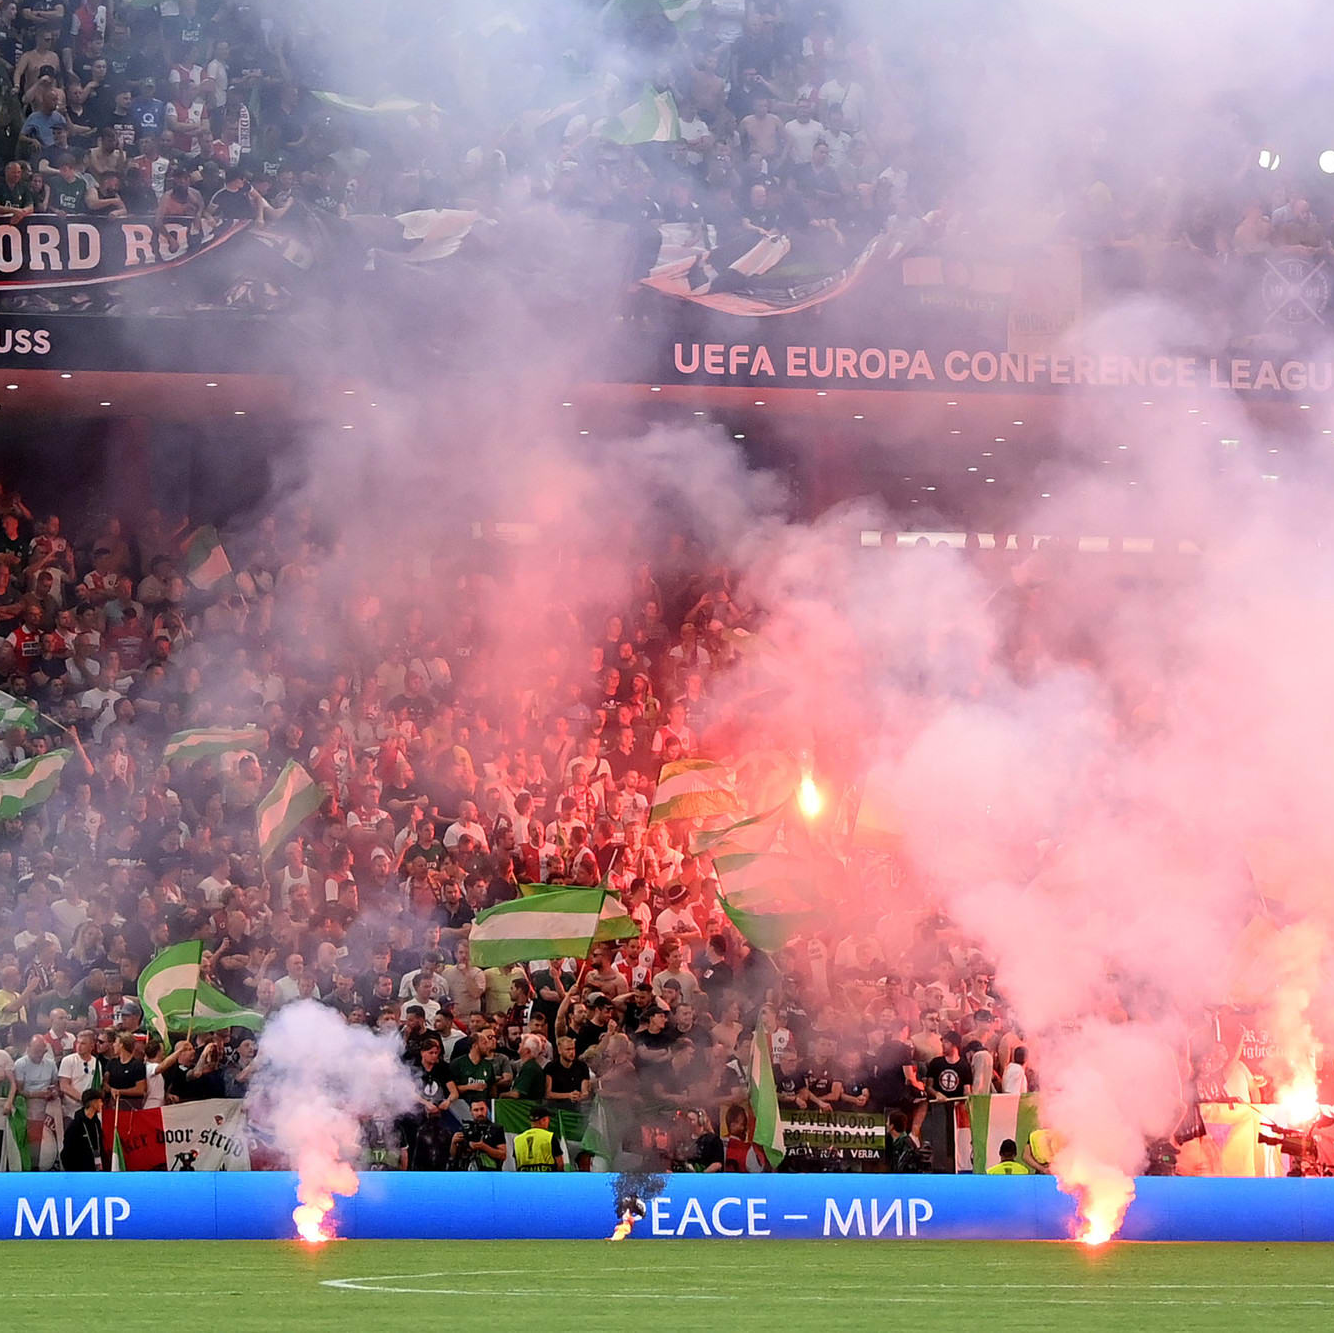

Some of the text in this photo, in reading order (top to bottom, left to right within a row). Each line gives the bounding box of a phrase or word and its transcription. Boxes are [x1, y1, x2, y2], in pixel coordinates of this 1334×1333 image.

[674, 343, 776, 376] UEFA
[786, 346, 936, 381] EUROPA
[944, 350, 1197, 386] CONFERENCE
[784, 1128, 876, 1144] ROTTERDAM
[850, 1149, 880, 1159] VERBA
[637, 1197, 771, 1236] EACE
